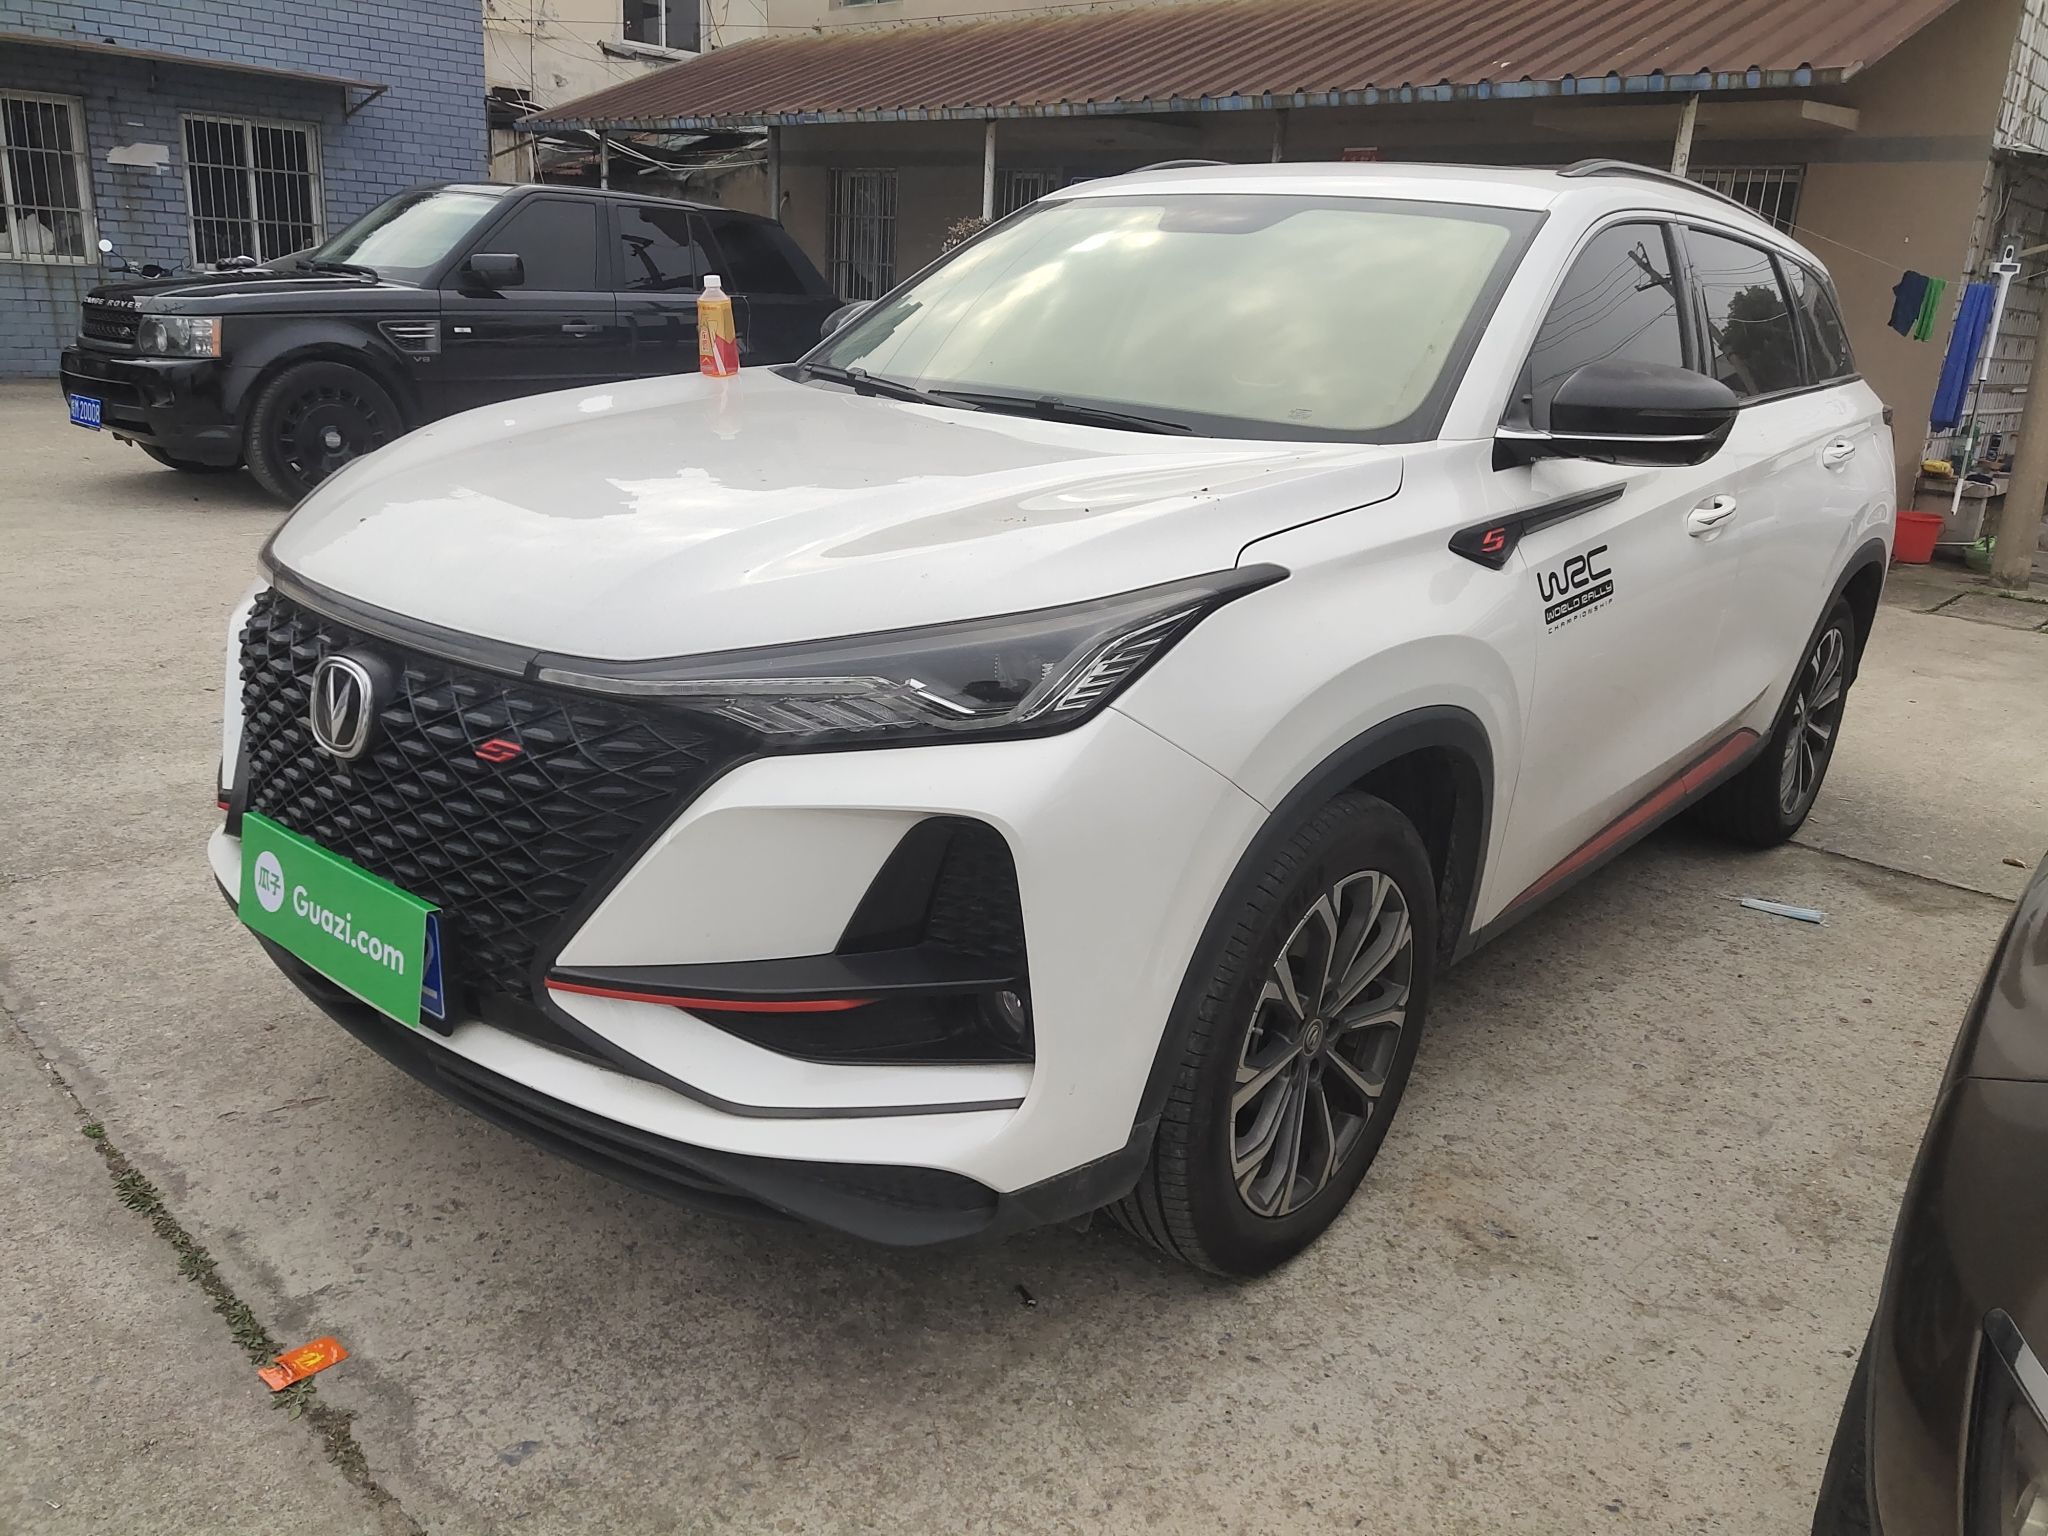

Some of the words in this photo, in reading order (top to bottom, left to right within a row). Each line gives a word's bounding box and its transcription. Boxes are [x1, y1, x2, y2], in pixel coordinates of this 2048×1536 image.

[107, 300, 143, 309] ROVER
[1537, 545, 1612, 602] WRC
[1547, 598, 1580, 621] WORLD
[1581, 582, 1613, 605] RALLY
[1548, 598, 1613, 634] CHAMPIONSHIP
[259, 867, 281, 896] 瓜子
[293, 885, 404, 975] Guazi.com
